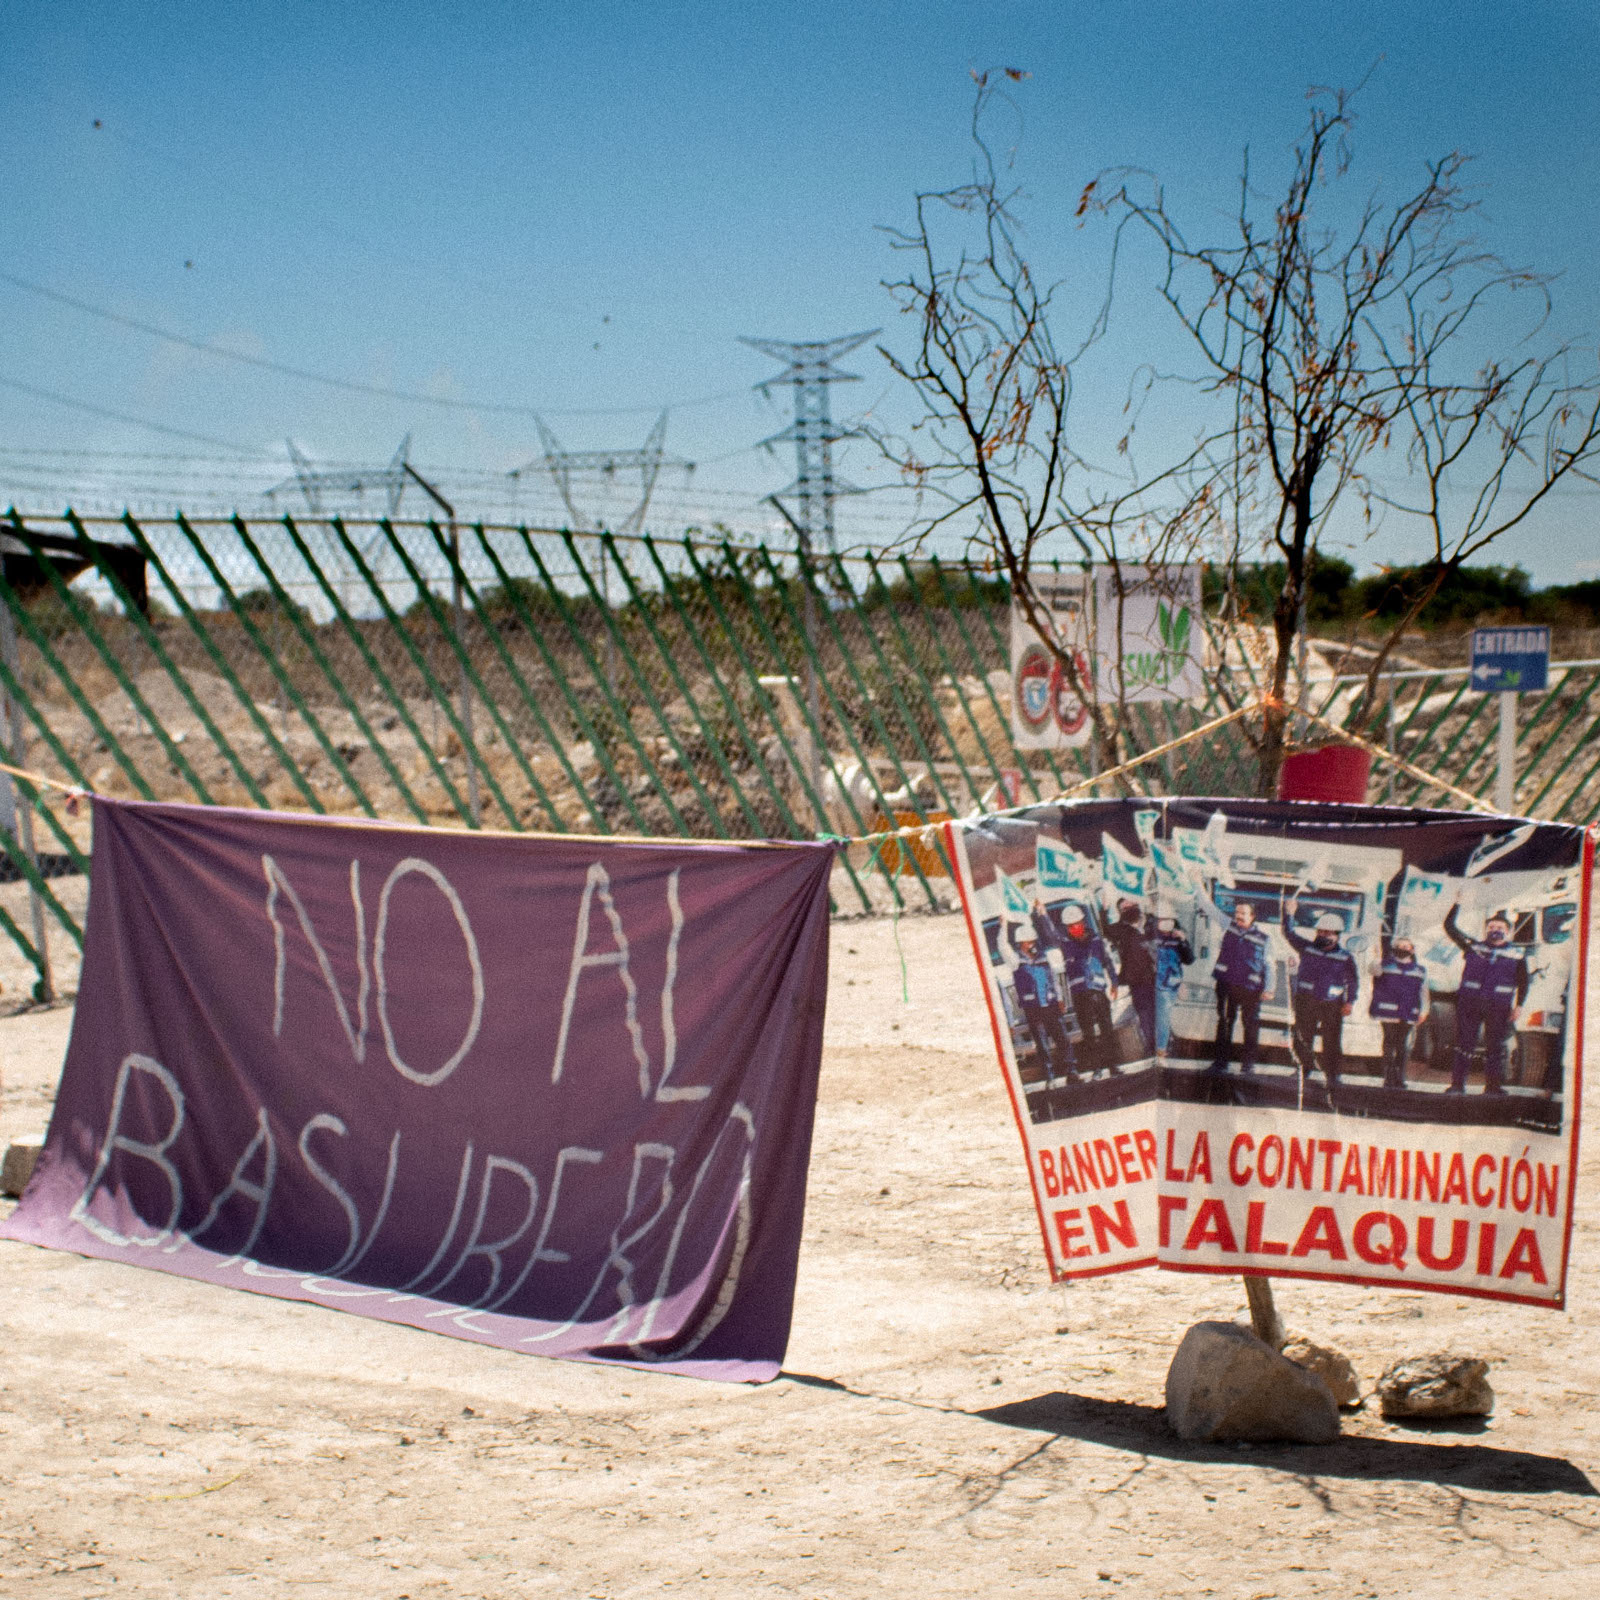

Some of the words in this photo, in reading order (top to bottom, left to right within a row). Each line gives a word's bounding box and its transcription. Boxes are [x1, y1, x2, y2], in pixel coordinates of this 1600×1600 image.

[1474, 631, 1547, 654] ENTRADA
[261, 854, 485, 1087] NO
[551, 862, 712, 1102] AL
[69, 1052, 756, 1362] BASURERO
[1164, 1128, 1213, 1185] LA
[1228, 1132, 1560, 1218] CONTAMINACIÓN
[1052, 1199, 1139, 1260] EN
